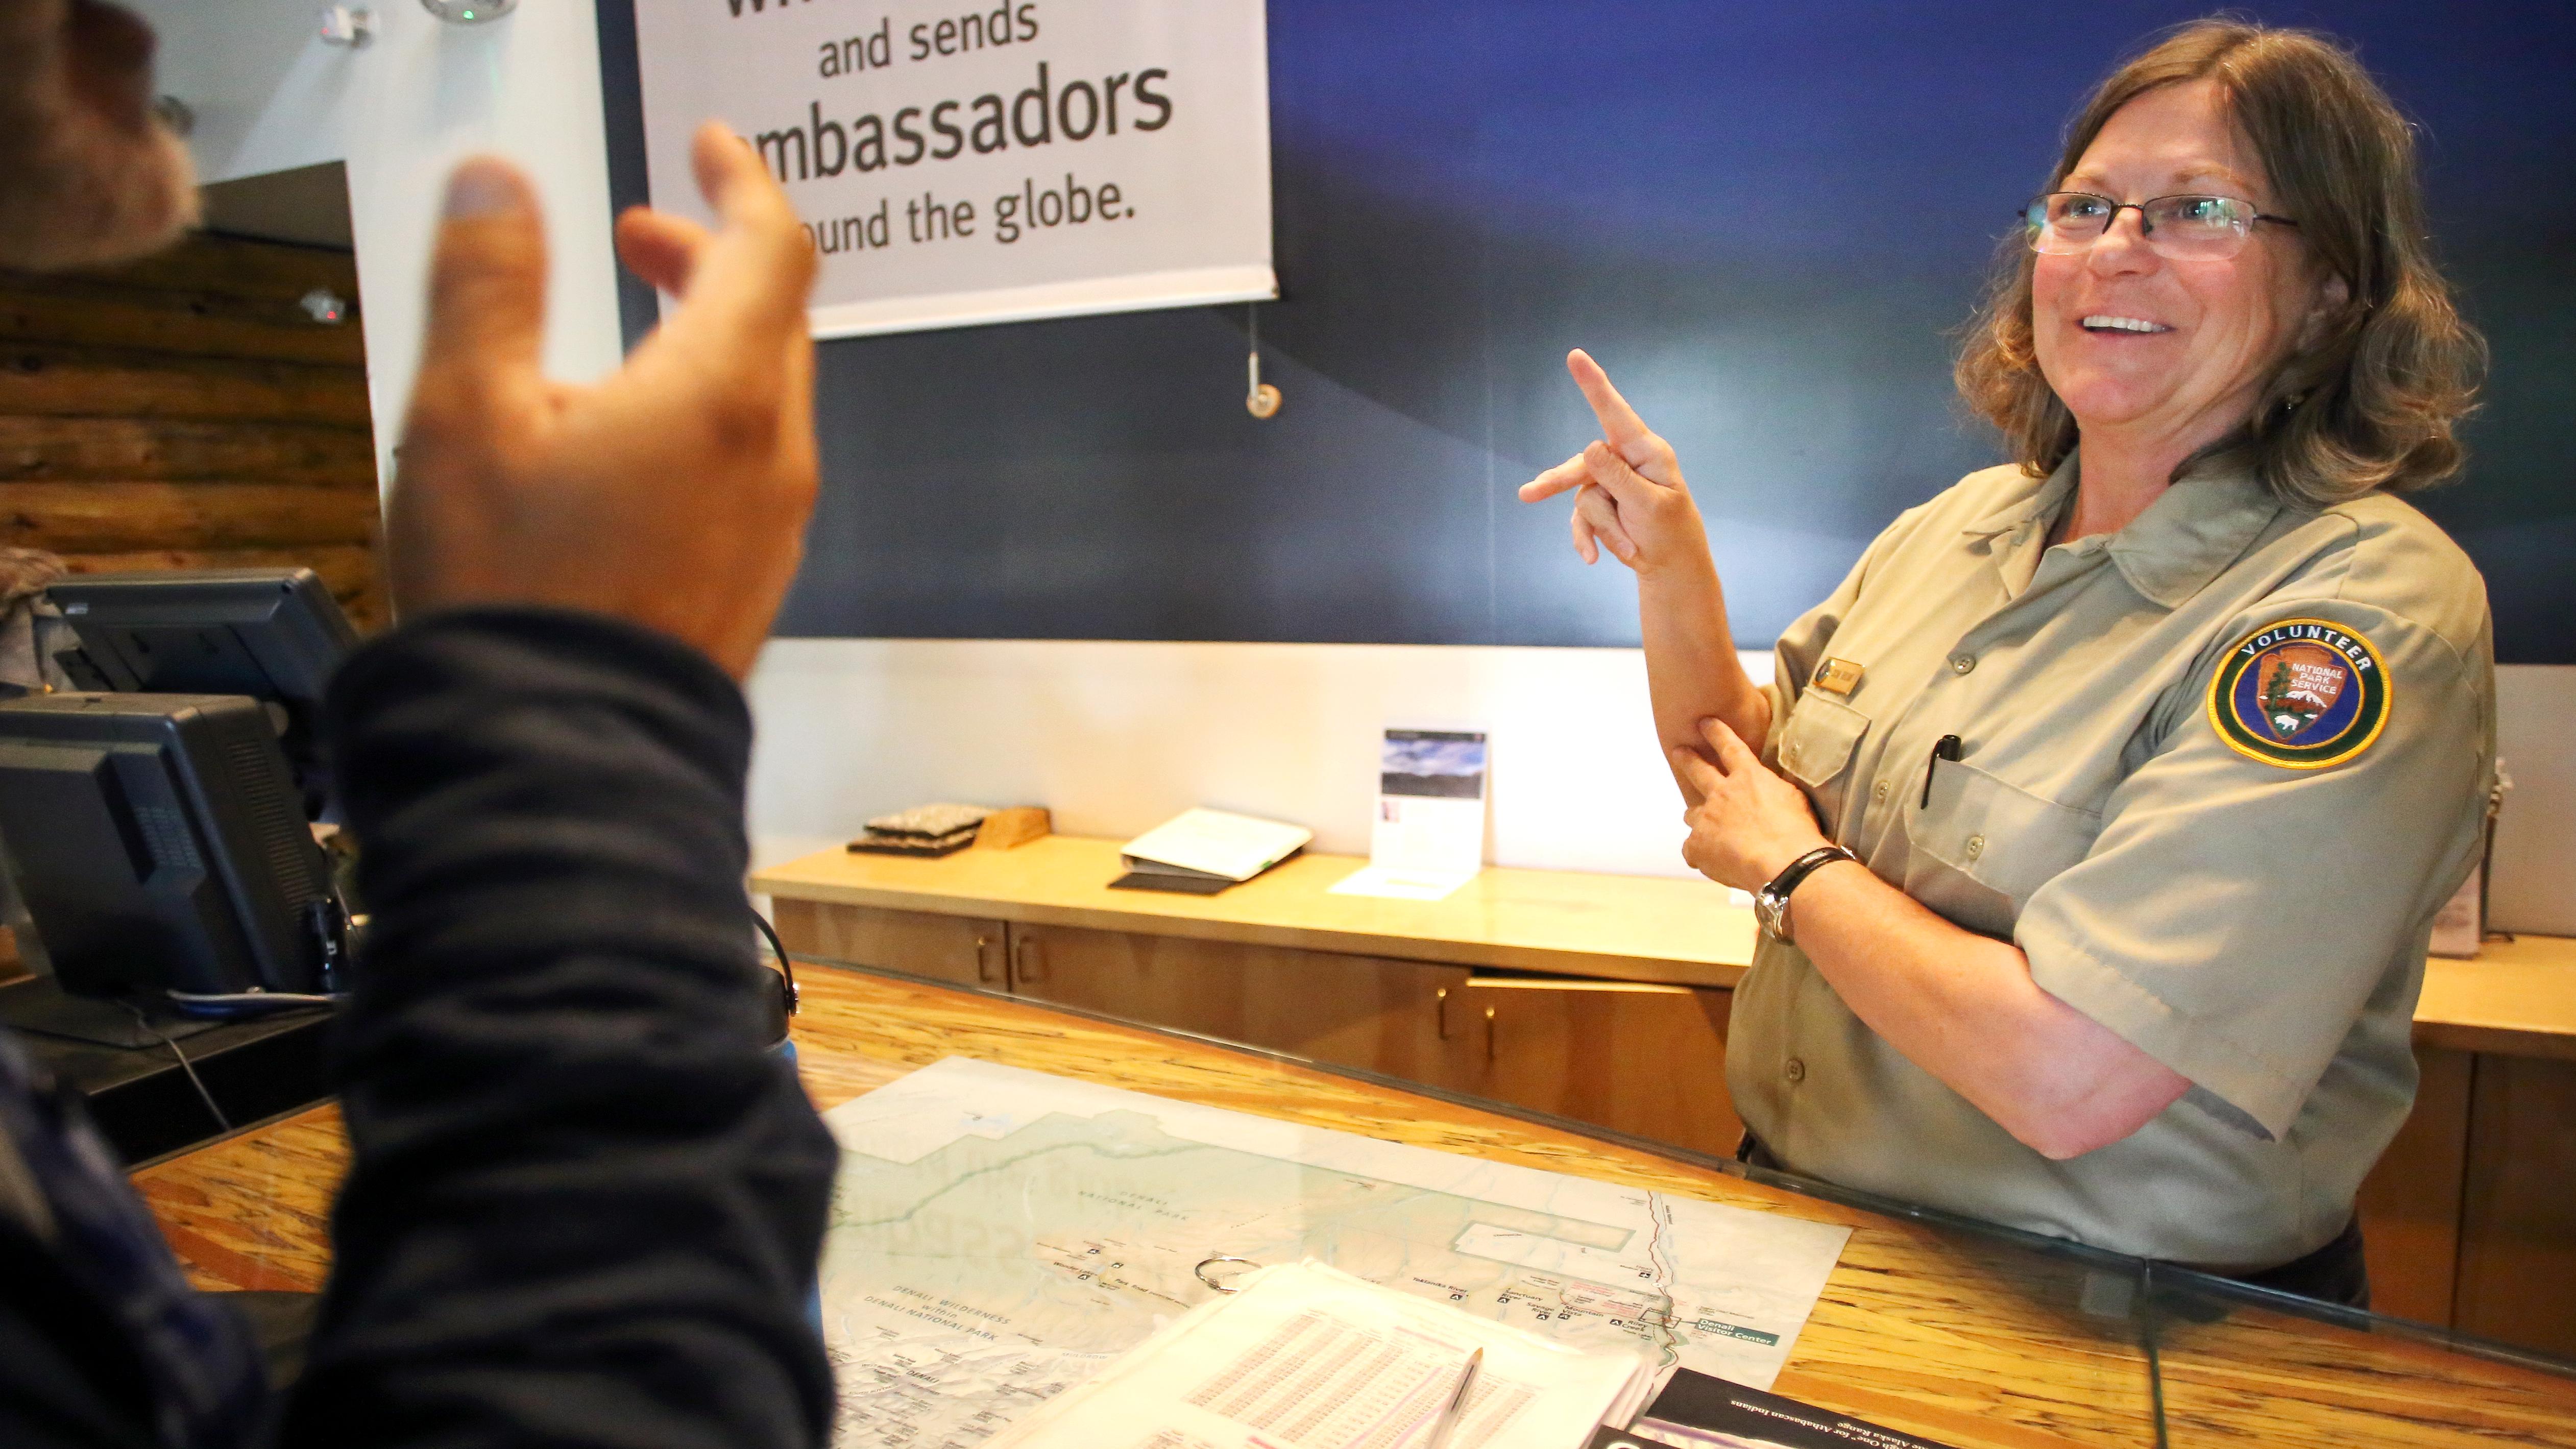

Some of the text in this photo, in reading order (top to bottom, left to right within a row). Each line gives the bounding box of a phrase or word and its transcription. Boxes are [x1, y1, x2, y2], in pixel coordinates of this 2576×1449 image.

[820, 0, 1039, 78] and sends
[737, 61, 1173, 183] mbassadors
[800, 173, 1135, 253] ound the globe.
[2242, 625, 2372, 670] VOLUNTEER
[2292, 663, 2343, 679] NATIONAL
[2299, 673, 2330, 685] PARK
[2291, 680, 2337, 694] SERVICE
[1413, 1277, 1468, 1293] Teklanika River
[1505, 1290, 1544, 1301] Sanctuary
[893, 1286, 1012, 1324] DENALI WILDERNESS
[921, 1305, 958, 1319] within
[1527, 1302, 1555, 1312] Savage
[1565, 1305, 1604, 1317] Mountain
[864, 1296, 906, 1312] DENALI
[907, 1309, 964, 1331] NATIONAL
[966, 1327, 999, 1341] PARK
[1700, 1319, 1736, 1331] Denali
[1622, 1323, 1644, 1332] Creek
[1698, 1324, 1734, 1336] Visitor
[1735, 1332, 1772, 1345] Center
[906, 1369, 940, 1384] DENALI
[1731, 1400, 1770, 1416] Indians
[1770, 1412, 1833, 1433] Athabascan
[1837, 1422, 1872, 1437] Range
[1833, 1430, 1851, 1438] for
[1873, 1432, 1911, 1447] Alaska
